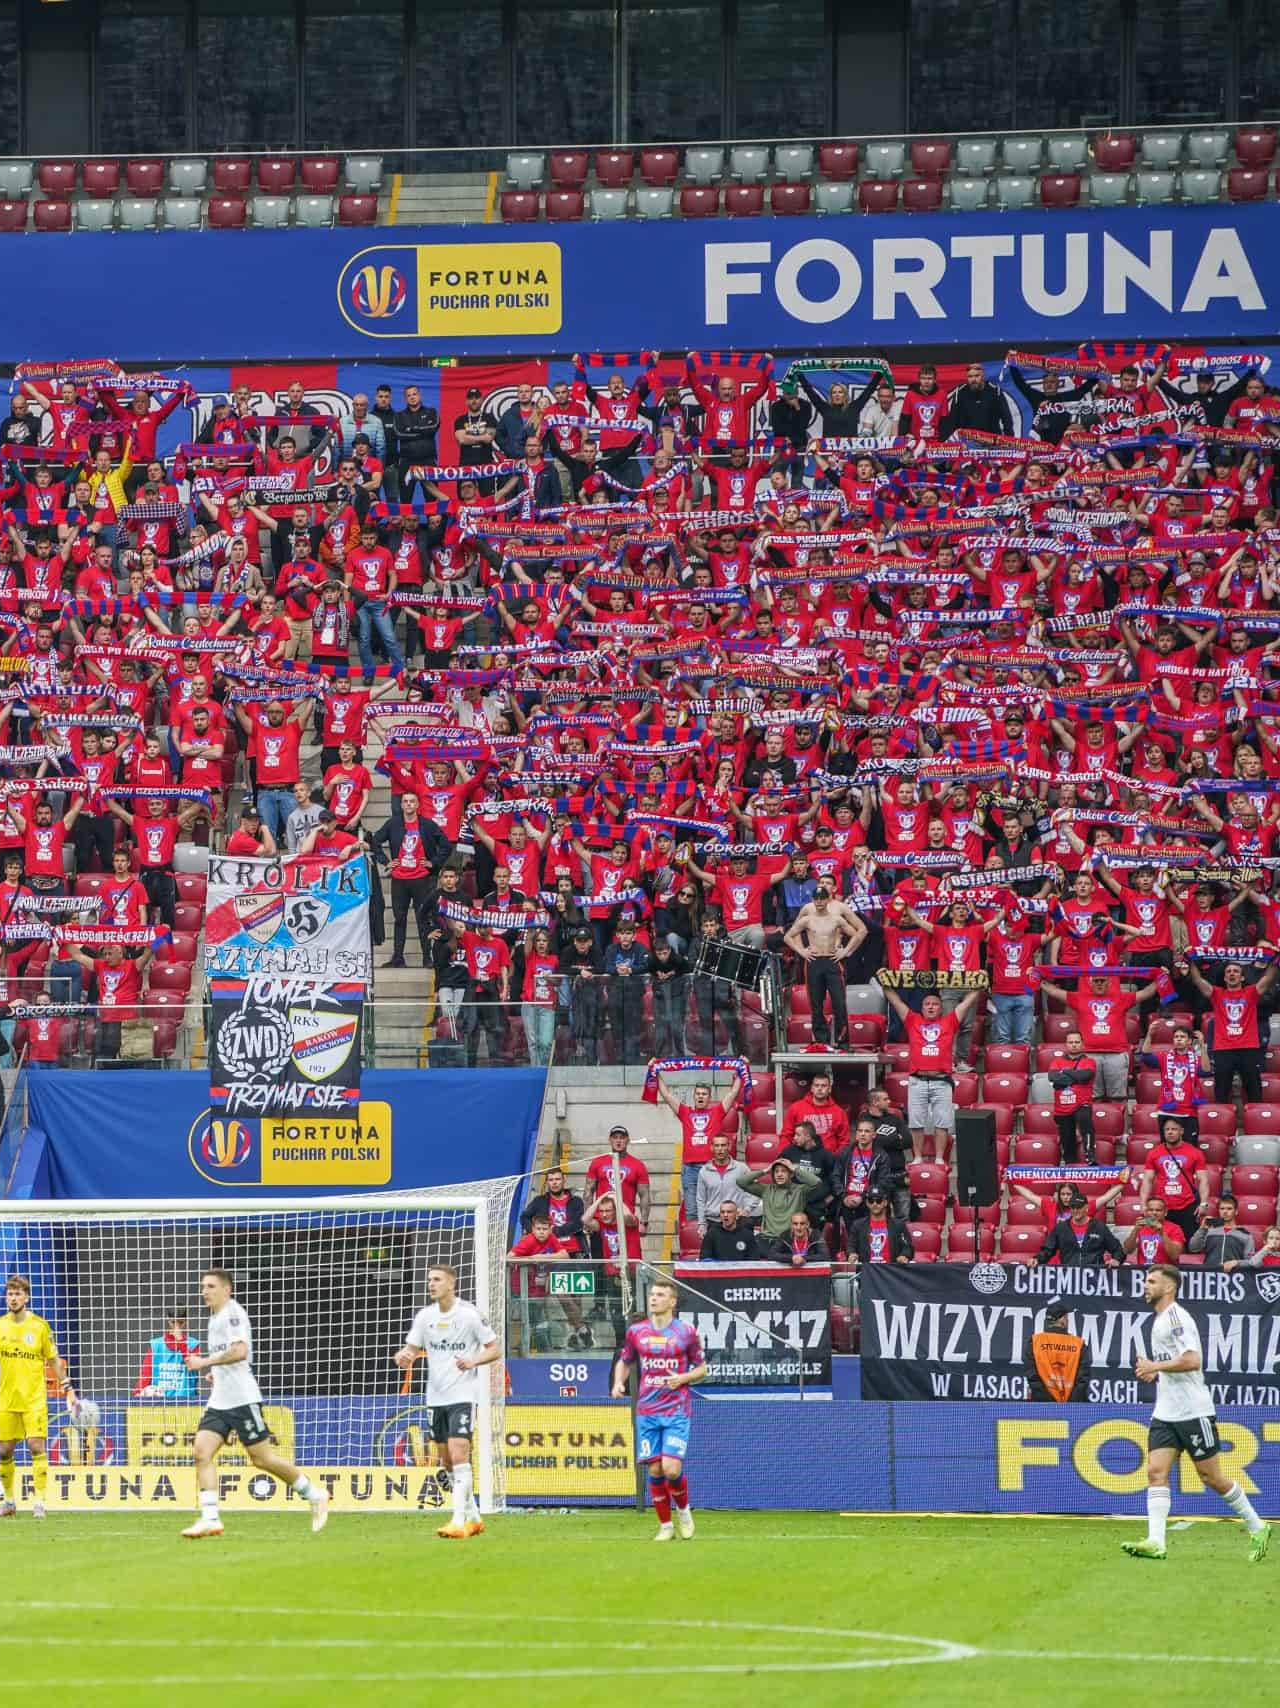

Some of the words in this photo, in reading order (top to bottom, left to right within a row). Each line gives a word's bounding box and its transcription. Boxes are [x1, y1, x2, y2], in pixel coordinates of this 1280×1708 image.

[430, 270, 548, 286] FORTUNA
[705, 228, 1267, 325] FORTUNA
[430, 295, 490, 310] PUCHAR
[495, 293, 550, 308] POLSKI
[575, 622, 613, 634] ALEJA
[1050, 614, 1073, 631] THE
[690, 700, 711, 715] THE
[208, 858, 361, 896] KRÓLIK
[951, 871, 1006, 888] OSTATNI
[1195, 946, 1263, 958] RACOVIA
[242, 977, 342, 1013] TOMEK
[293, 1015, 320, 1027] RKS
[231, 1025, 276, 1060] ZWD
[273, 1126, 379, 1141] FORTUNA
[273, 1147, 326, 1161] PUCHAR
[331, 1146, 381, 1161] POLSKI
[1064, 1169, 1119, 1179] BROTHERS
[723, 1287, 783, 1302] CHEMIK
[1013, 1268, 1124, 1299] CHEMICAL
[1133, 1272, 1247, 1305] BTHERS
[549, 1364, 589, 1389] S08
[932, 1371, 953, 1398] W
[505, 1432, 627, 1448] ORTUNA
[565, 1456, 628, 1469] POLSKI
